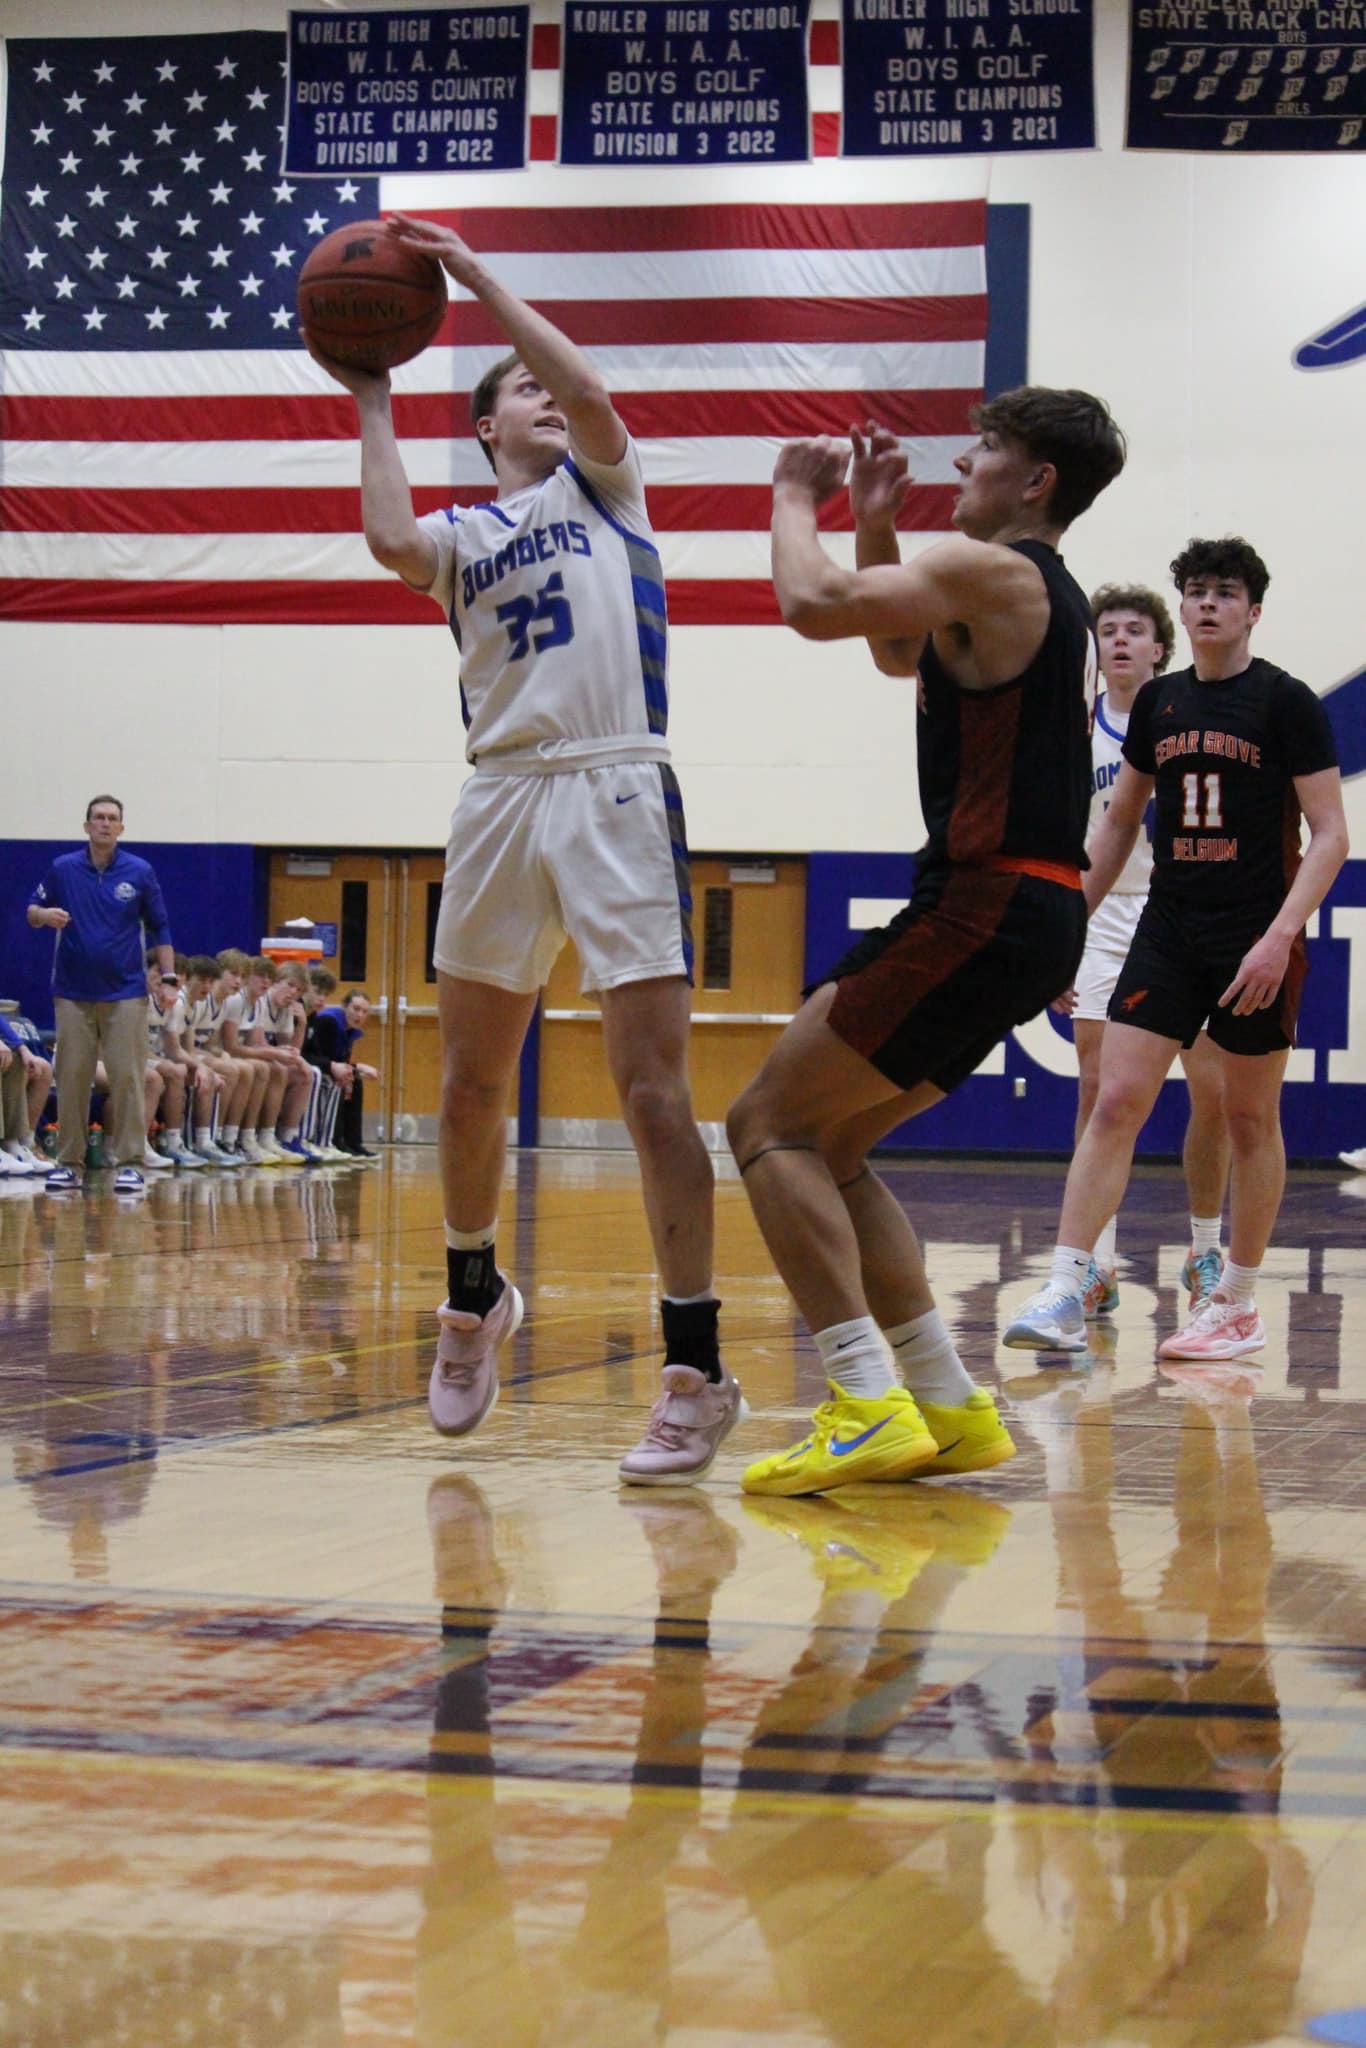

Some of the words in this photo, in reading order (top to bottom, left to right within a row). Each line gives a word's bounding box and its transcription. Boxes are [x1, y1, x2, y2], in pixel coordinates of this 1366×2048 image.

[573, 10, 647, 33] KOHLER
[666, 10, 709, 32] HIGH
[729, 6, 800, 31] SCHOOL
[854, 0, 926, 20] KOHLER
[946, 0, 989, 18] HIGH
[1009, 0, 1080, 16] SCHOOL
[1138, 9, 1208, 29] STATE
[1224, 10, 1300, 30] TRACK
[298, 21, 369, 44] KOHLER
[388, 20, 430, 42] HIGH
[449, 17, 520, 40] SCHOOL
[904, 27, 932, 49] W.
[972, 26, 995, 48] A.
[1008, 24, 1031, 47] A.
[1278, 31, 1307, 43] BOYS
[348, 52, 374, 73] W.
[411, 51, 432, 71] A.
[446, 49, 468, 70] A.
[625, 41, 652, 63] W.
[691, 41, 713, 62] A.
[727, 40, 748, 62] A.
[888, 58, 958, 81] BOYS
[978, 54, 1048, 78] GOLF
[297, 82, 344, 104] BOYS
[357, 80, 418, 103] CROSS
[432, 77, 517, 101] COUNTRY
[607, 71, 676, 94] BOYS
[696, 69, 765, 93] GOLF
[591, 102, 653, 125] STATE
[672, 99, 780, 124] CHAMPIONS
[874, 90, 936, 113] STATE
[955, 86, 1062, 111] CHAMPIONS
[1275, 102, 1310, 115] GIRLS
[314, 112, 374, 135] STATE
[392, 108, 498, 133] CHAMPIONS
[880, 120, 962, 144] DIVISION
[982, 119, 993, 141] 3
[1012, 117, 1057, 141] 2021
[316, 141, 397, 165] DIVISION
[417, 140, 428, 163] 3
[446, 139, 493, 162] 2022
[594, 132, 678, 156] DIVISION
[697, 132, 708, 154] 3
[727, 130, 775, 154] 2022
[461, 520, 592, 609] BOMBERS
[496, 571, 575, 662] 35
[1203, 730, 1261, 769] GROVE
[1182, 772, 1223, 828] 11
[1173, 837, 1237, 861] BELGIUM
